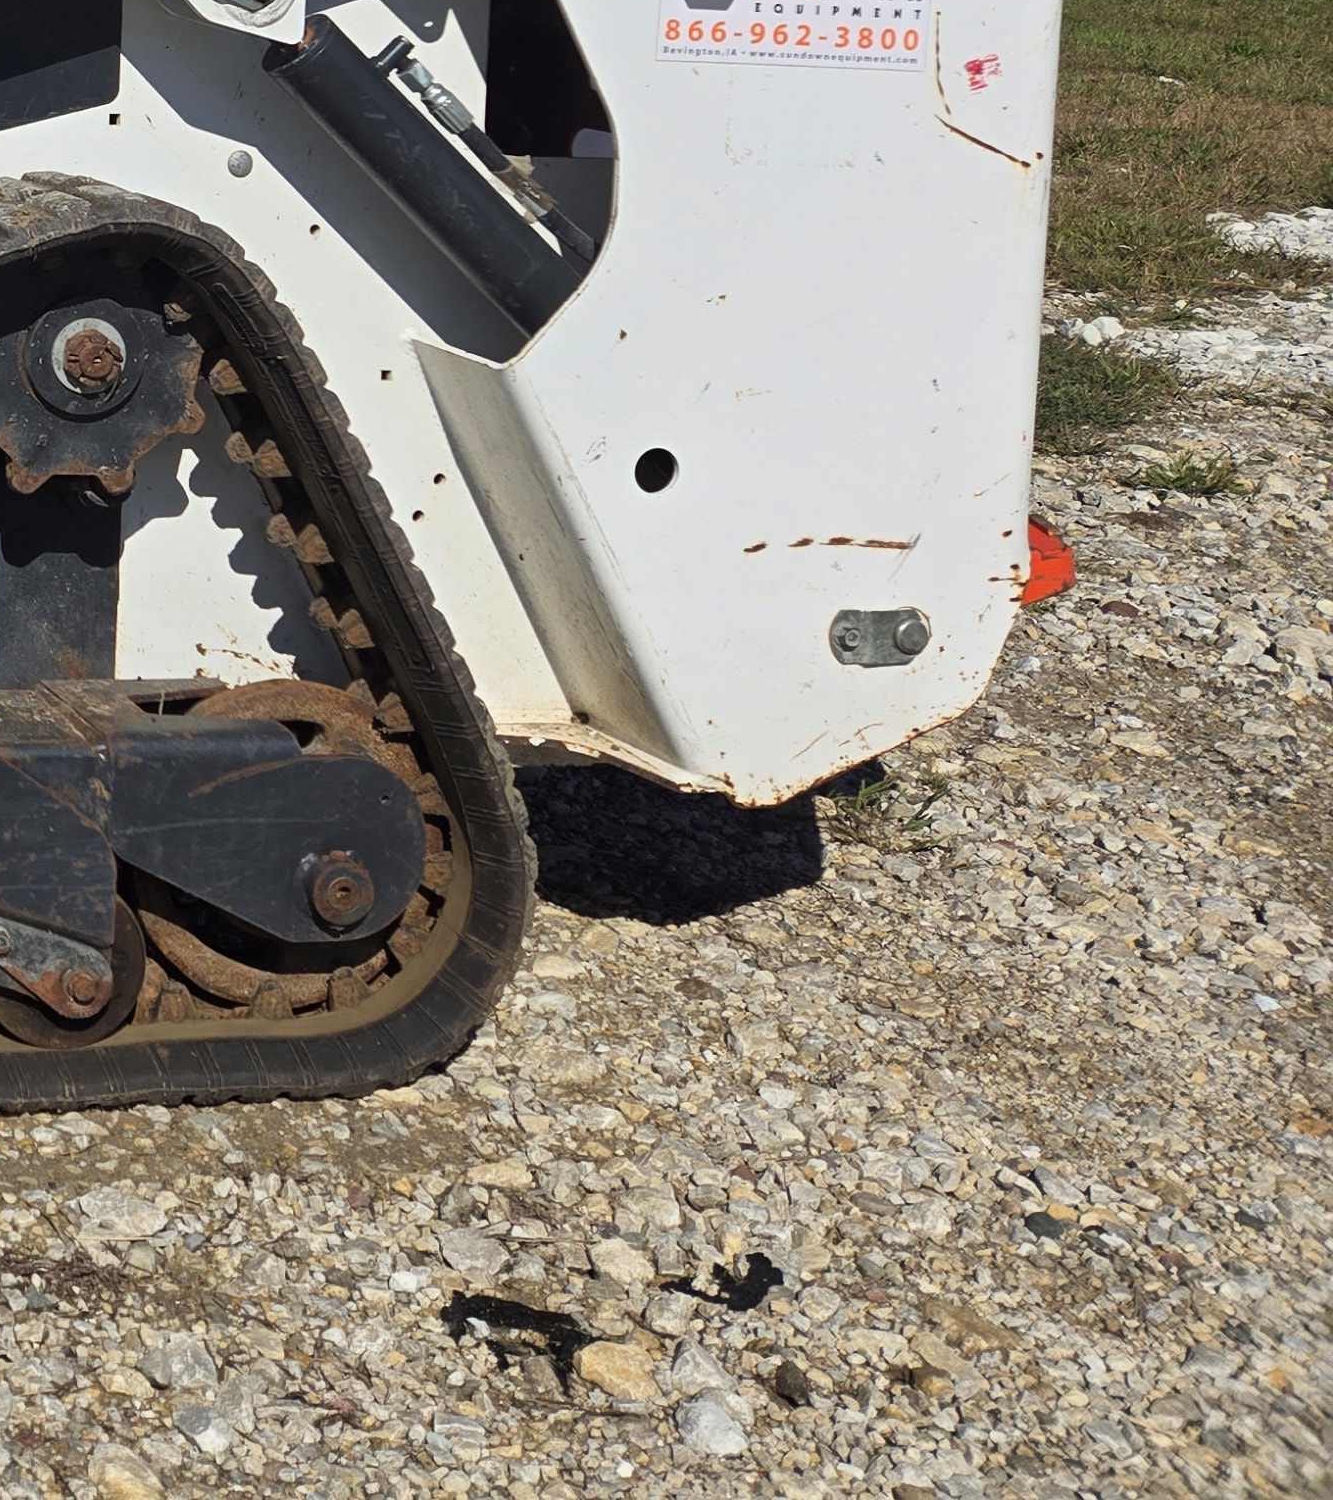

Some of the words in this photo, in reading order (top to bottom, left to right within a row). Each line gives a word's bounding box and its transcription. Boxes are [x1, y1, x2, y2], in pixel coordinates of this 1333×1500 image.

[753, 2, 923, 20] EQUIPMENT
[664, 18, 920, 52] 866-962-3800
[749, 50, 919, 65] www.sundownequipment.com
